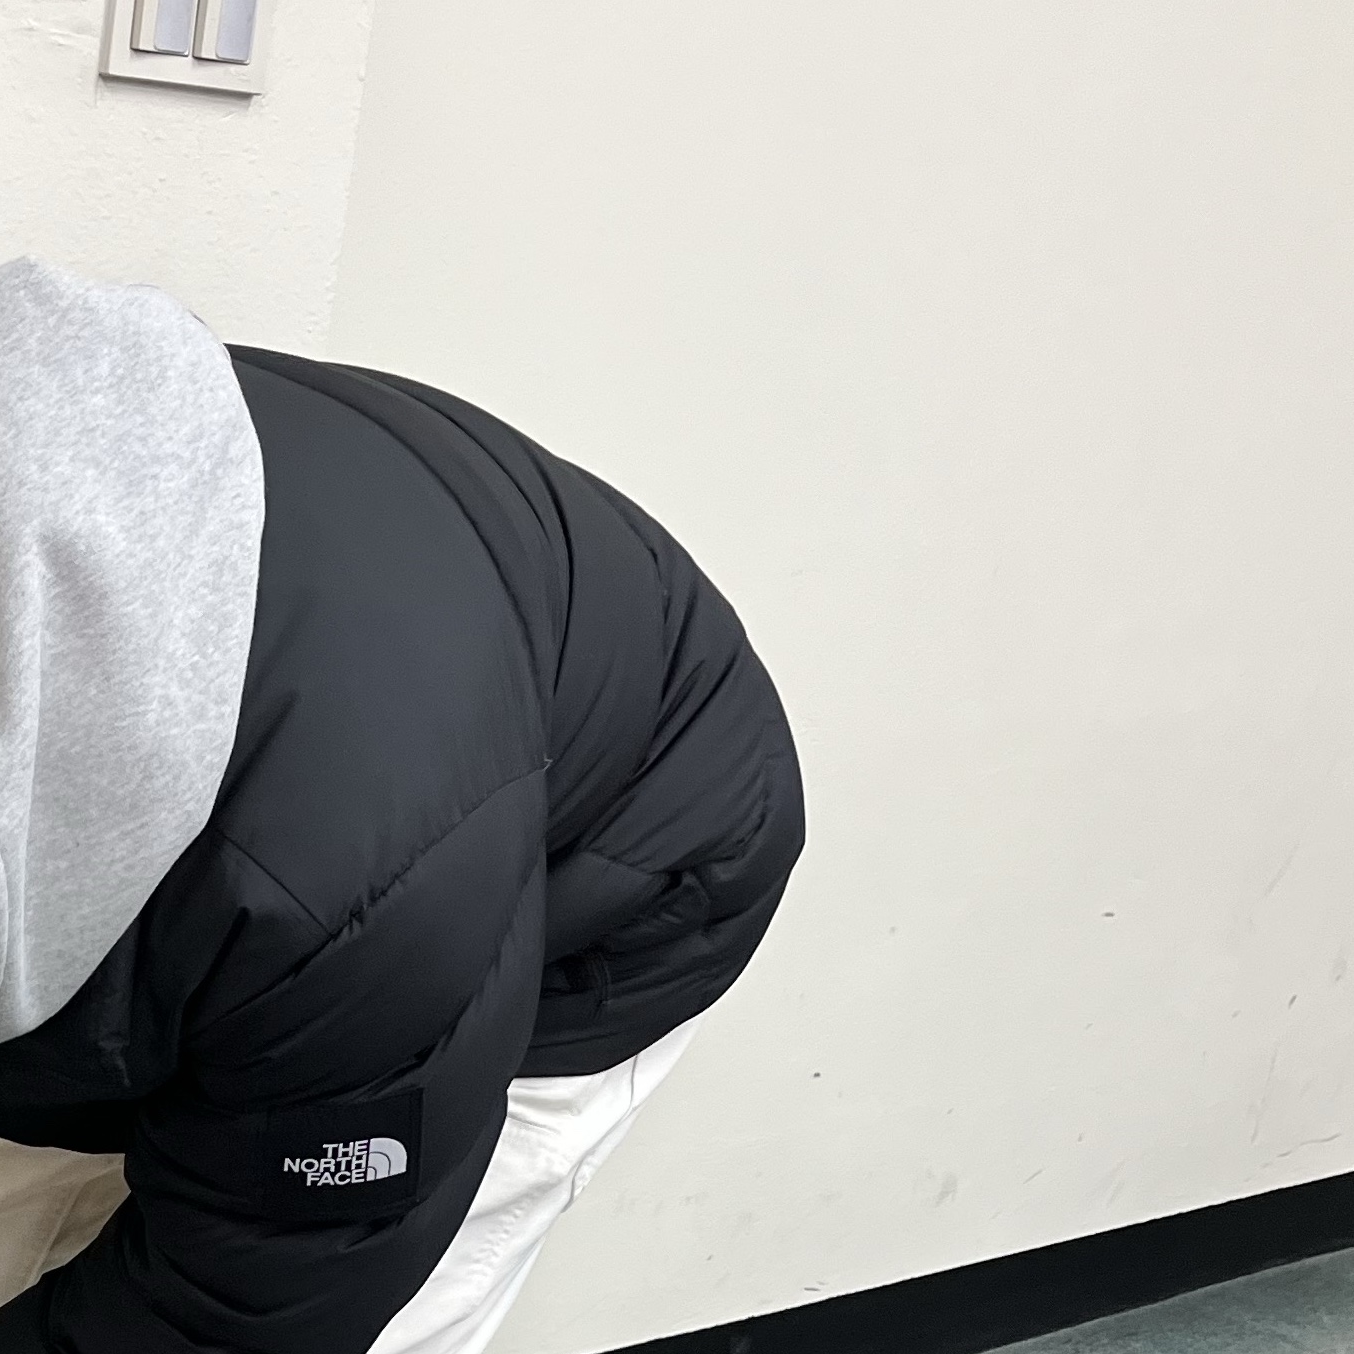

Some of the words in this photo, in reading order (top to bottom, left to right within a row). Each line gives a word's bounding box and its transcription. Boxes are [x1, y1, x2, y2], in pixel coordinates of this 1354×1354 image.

[323, 1140, 368, 1158] THE
[283, 1155, 366, 1173] NORTH
[306, 1168, 365, 1186] FACE
